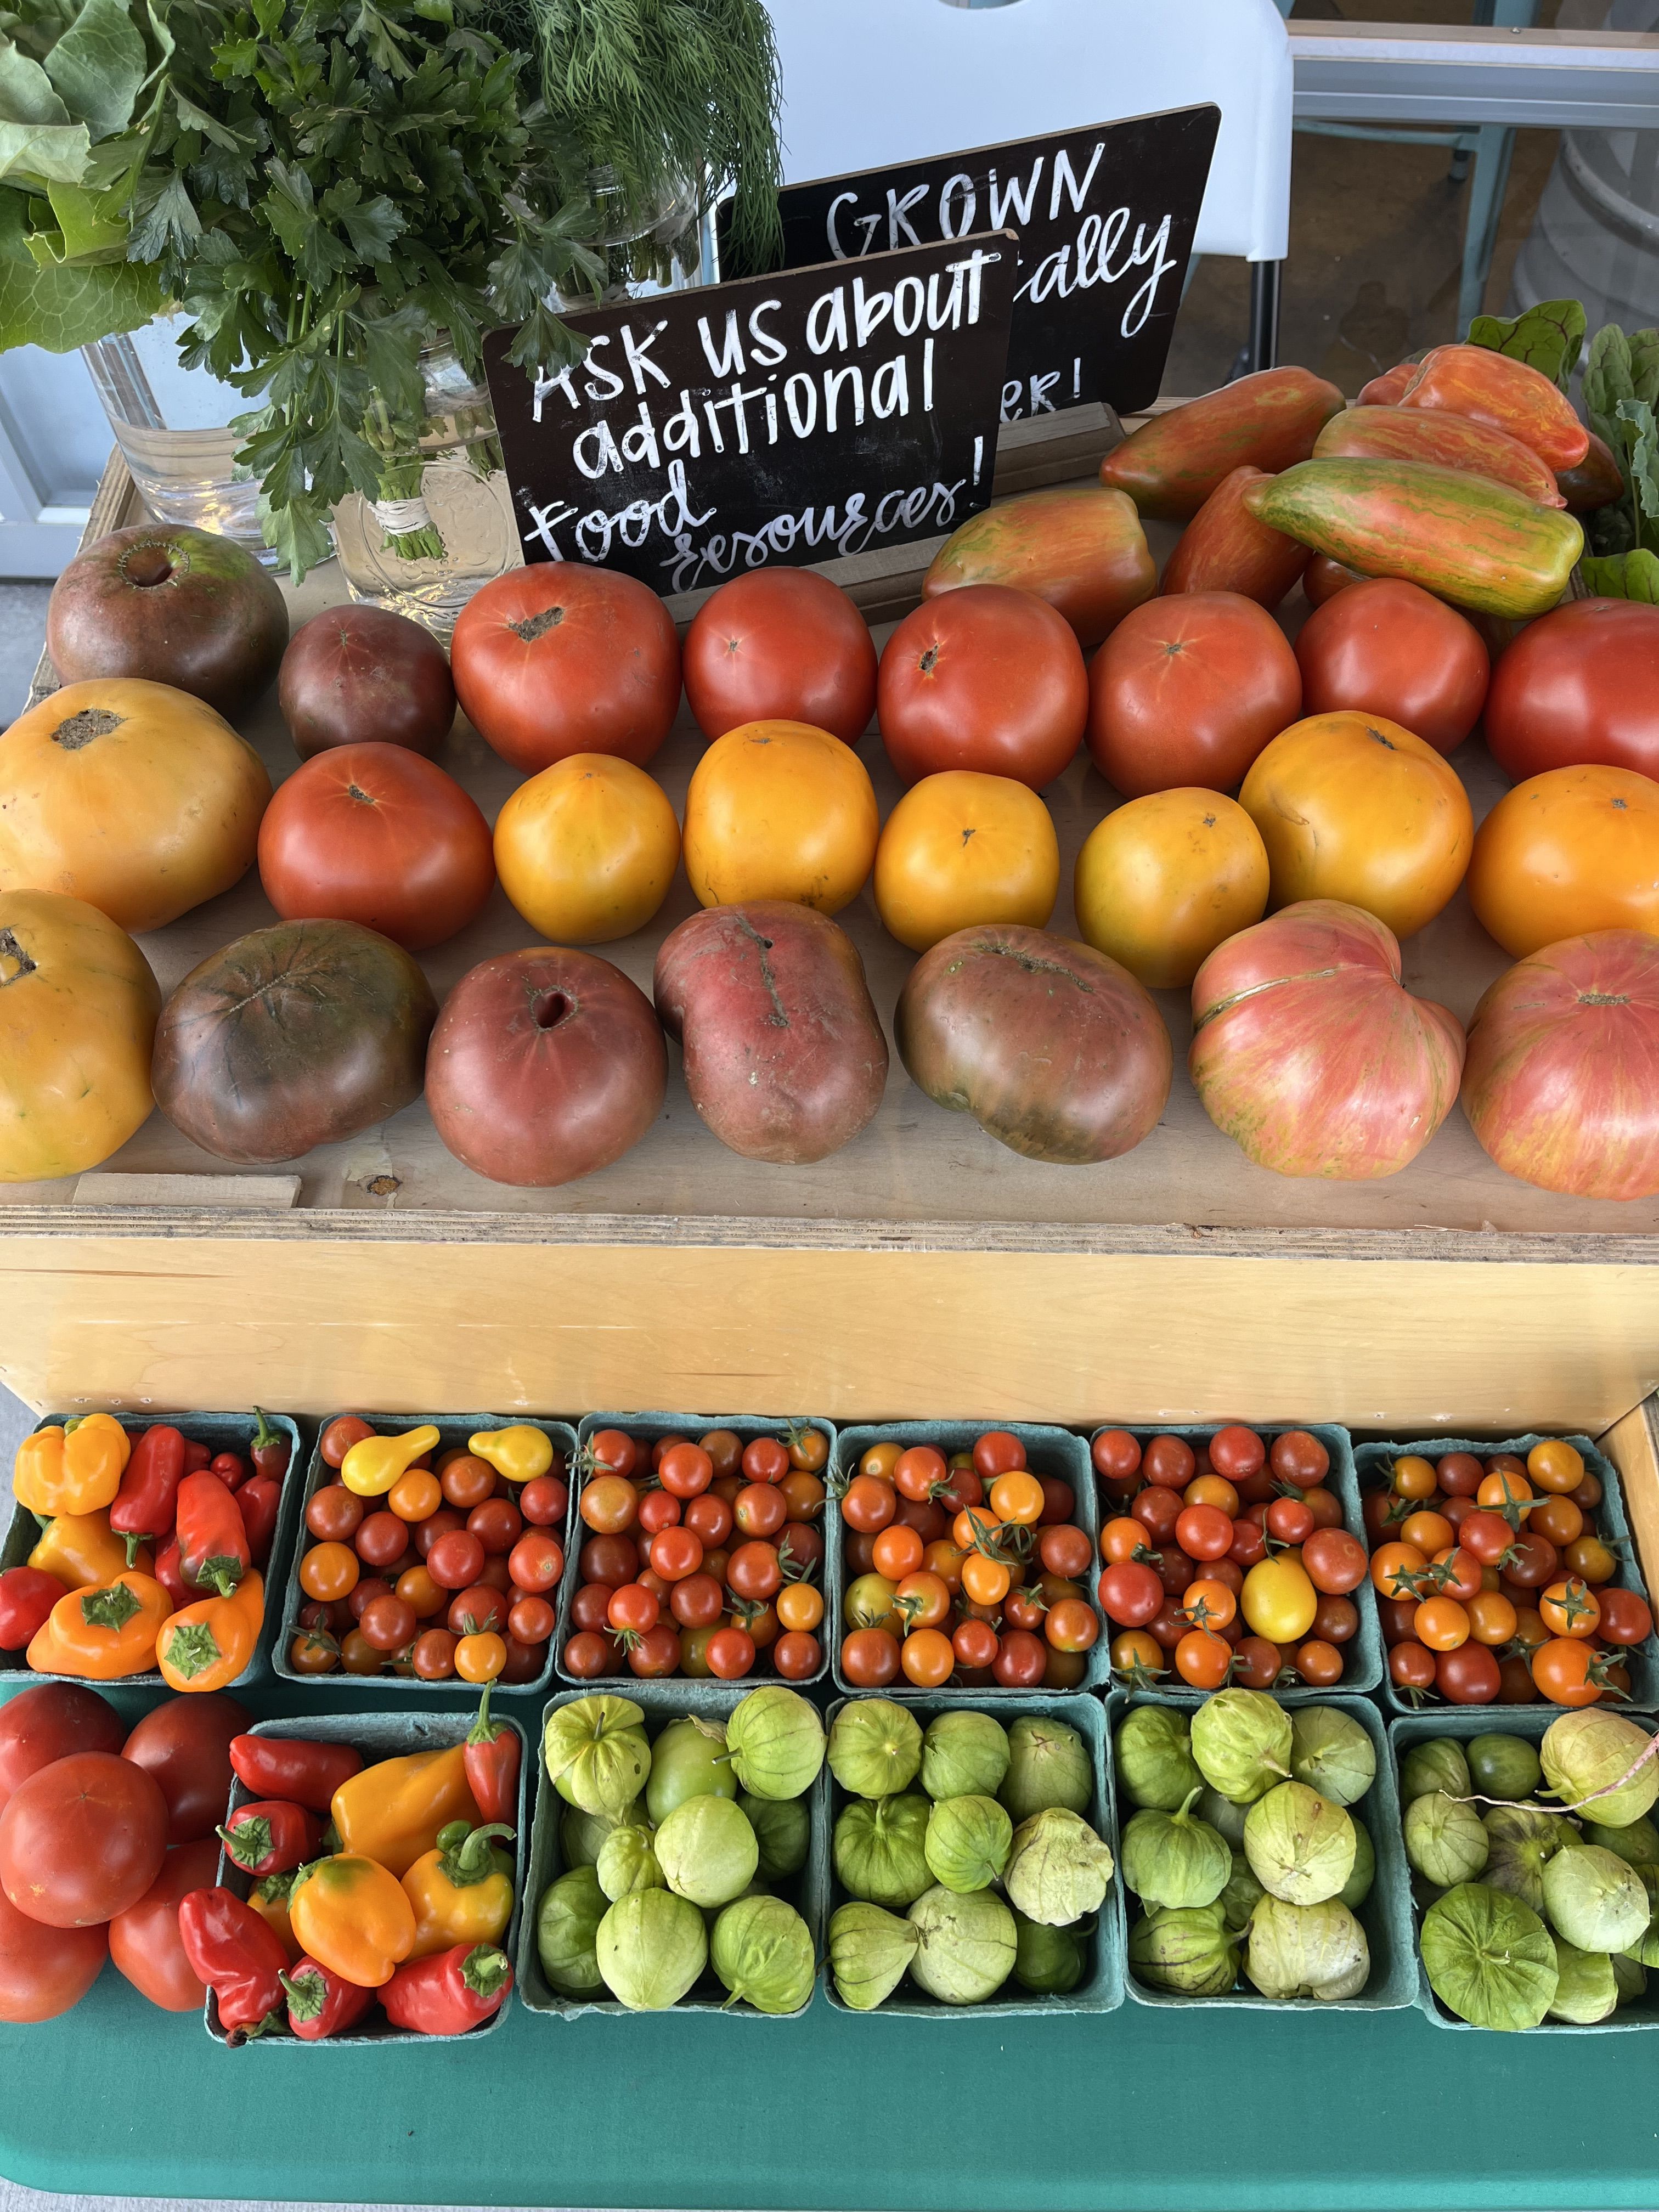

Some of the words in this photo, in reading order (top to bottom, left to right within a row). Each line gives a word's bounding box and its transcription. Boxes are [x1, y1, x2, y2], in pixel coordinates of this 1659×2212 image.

[826, 143, 1105, 260] GROWN
[532, 319, 672, 422] ASK
[806, 249, 1002, 356] about
[1013, 207, 1177, 338] ally
[573, 338, 934, 479] additional
